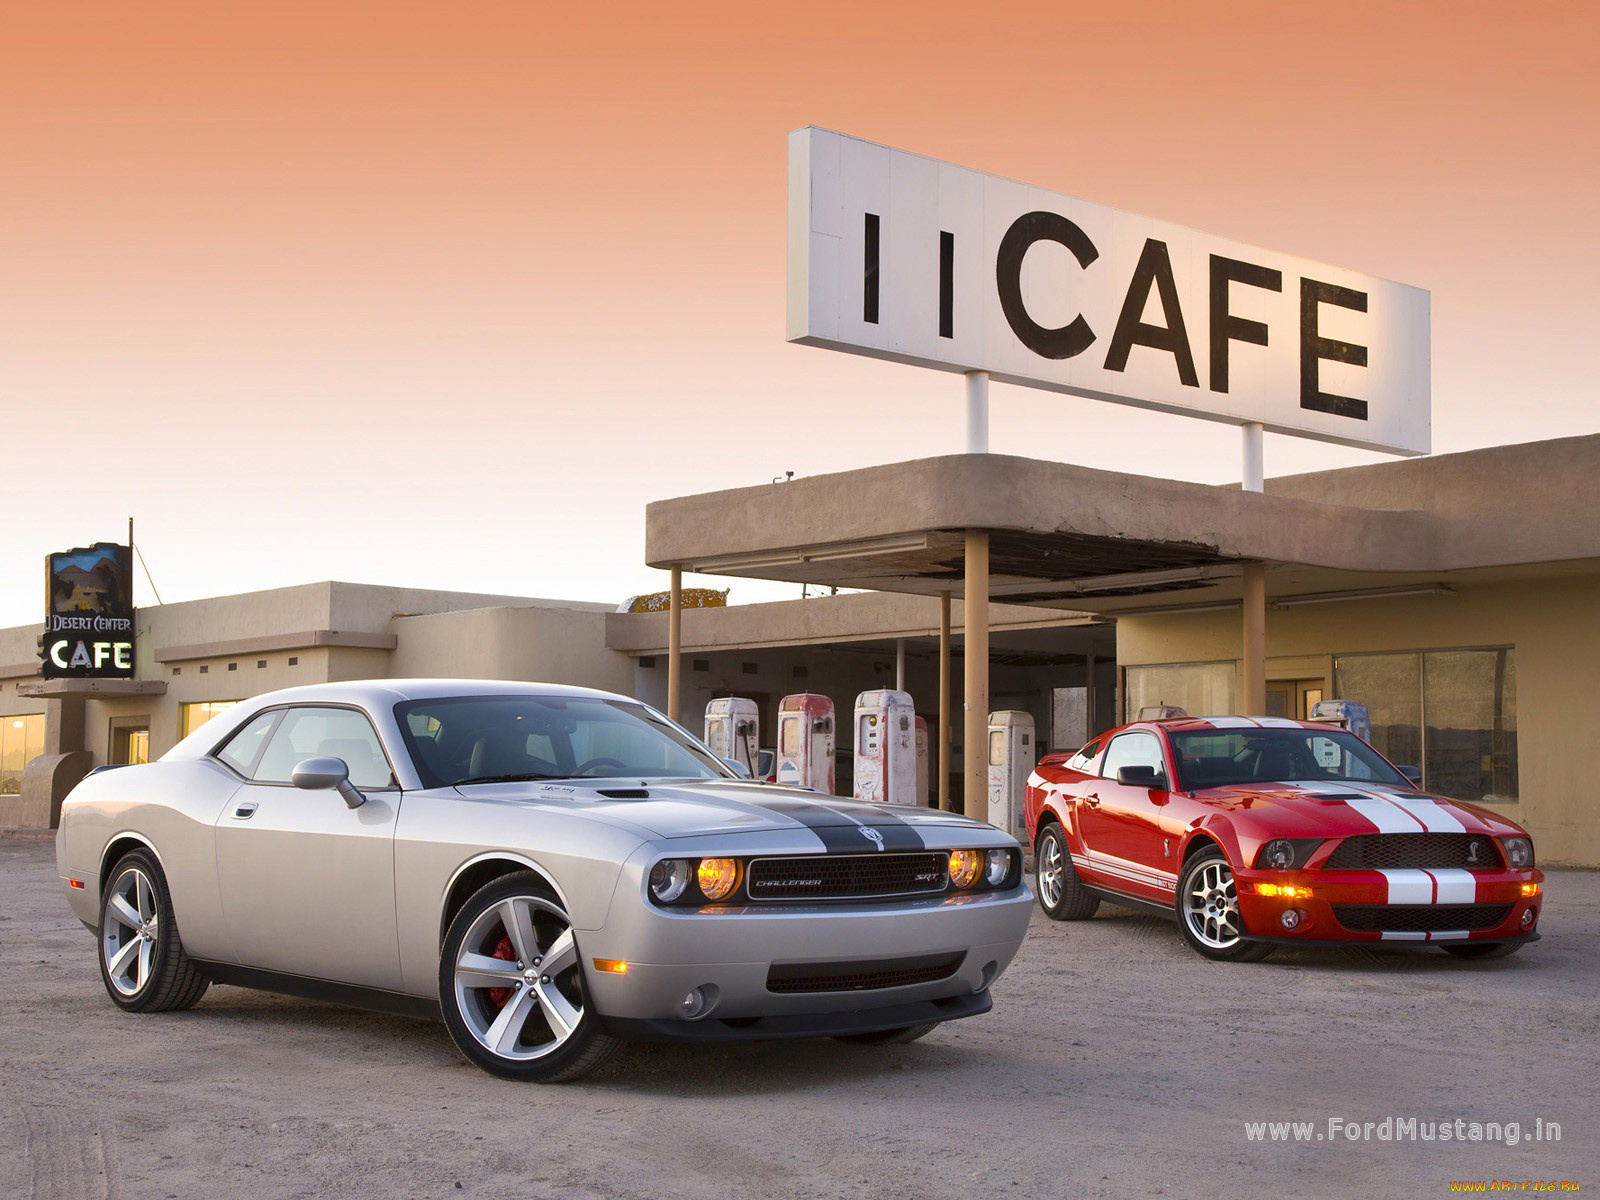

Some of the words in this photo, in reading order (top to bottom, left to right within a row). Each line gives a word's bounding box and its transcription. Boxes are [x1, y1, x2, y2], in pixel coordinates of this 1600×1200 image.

[996, 211, 1368, 420] CAFE
[52, 614, 92, 631] DESERT
[94, 615, 131, 632] CENTER
[50, 640, 132, 669] CAFE
[756, 879, 822, 887] CHALLENGER
[914, 873, 939, 881] SRT
